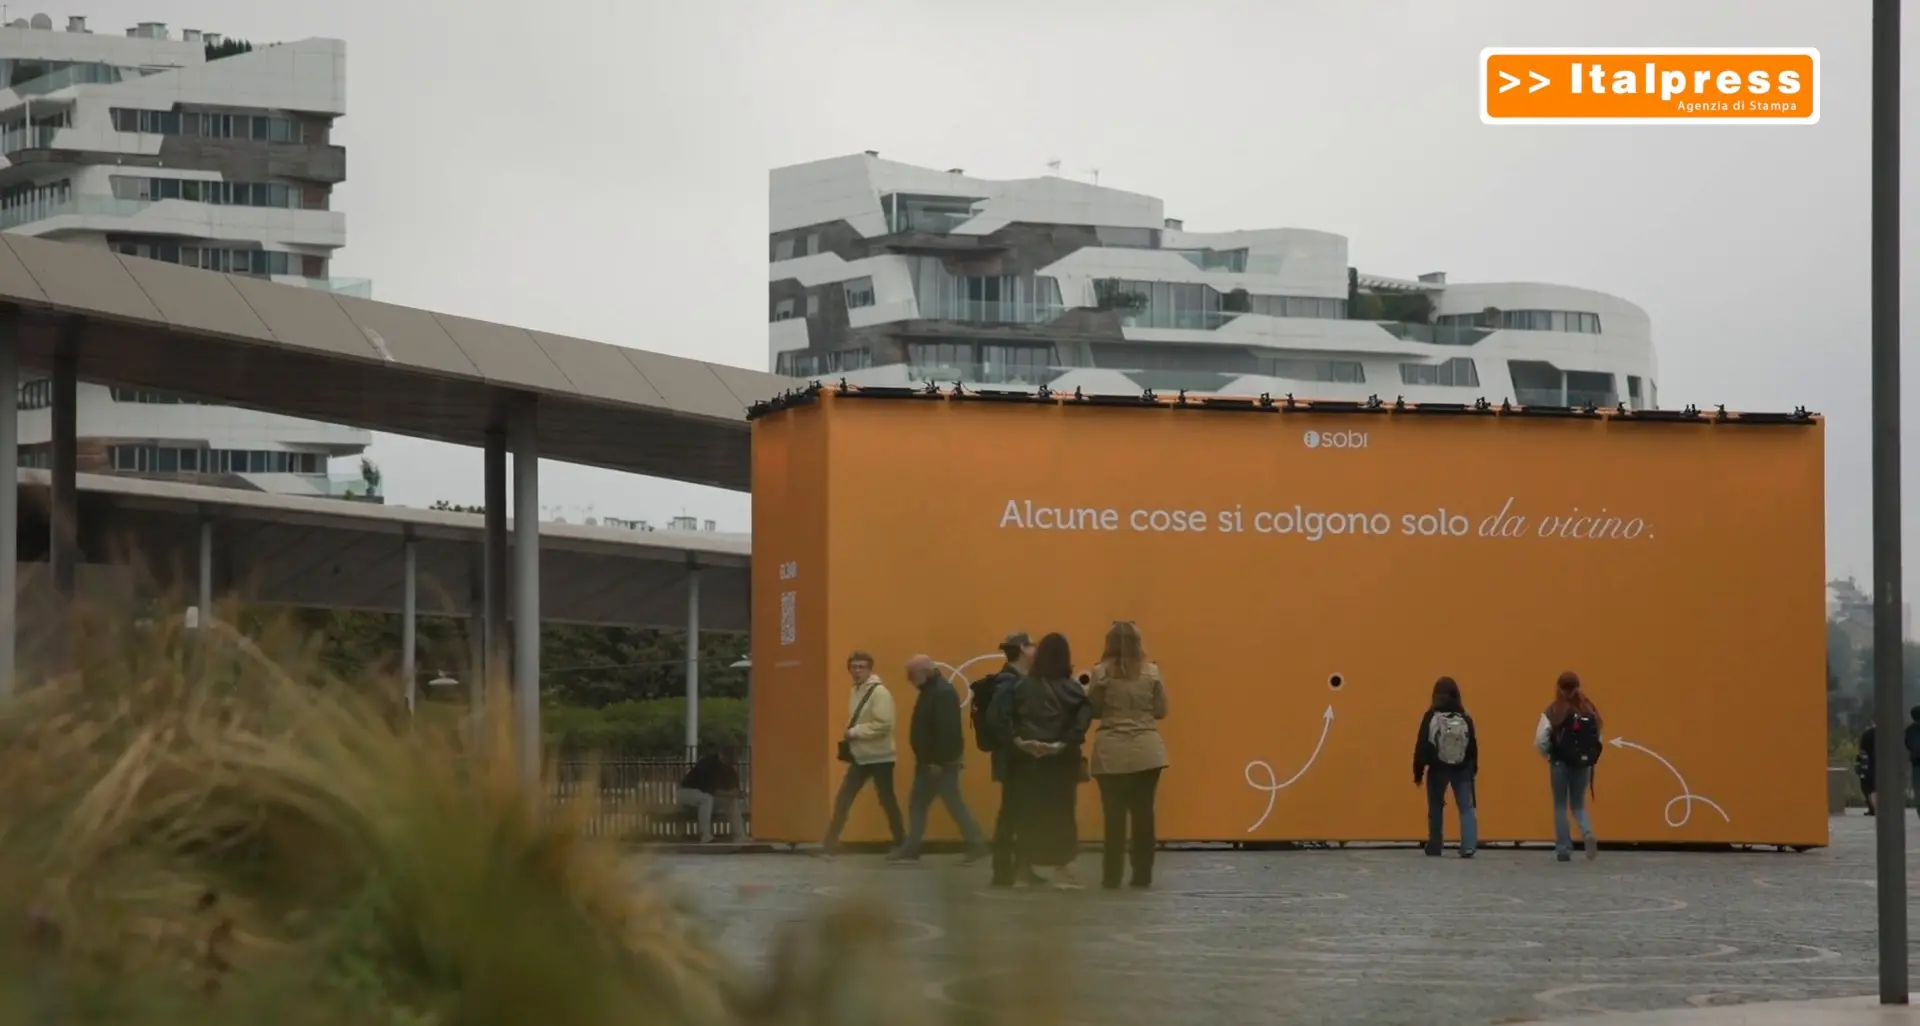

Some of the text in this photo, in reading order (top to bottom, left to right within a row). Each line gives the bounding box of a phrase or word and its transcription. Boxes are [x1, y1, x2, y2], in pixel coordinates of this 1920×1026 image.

[1000, 496, 1655, 542] Alcune cose si colgono solo da vicino.
